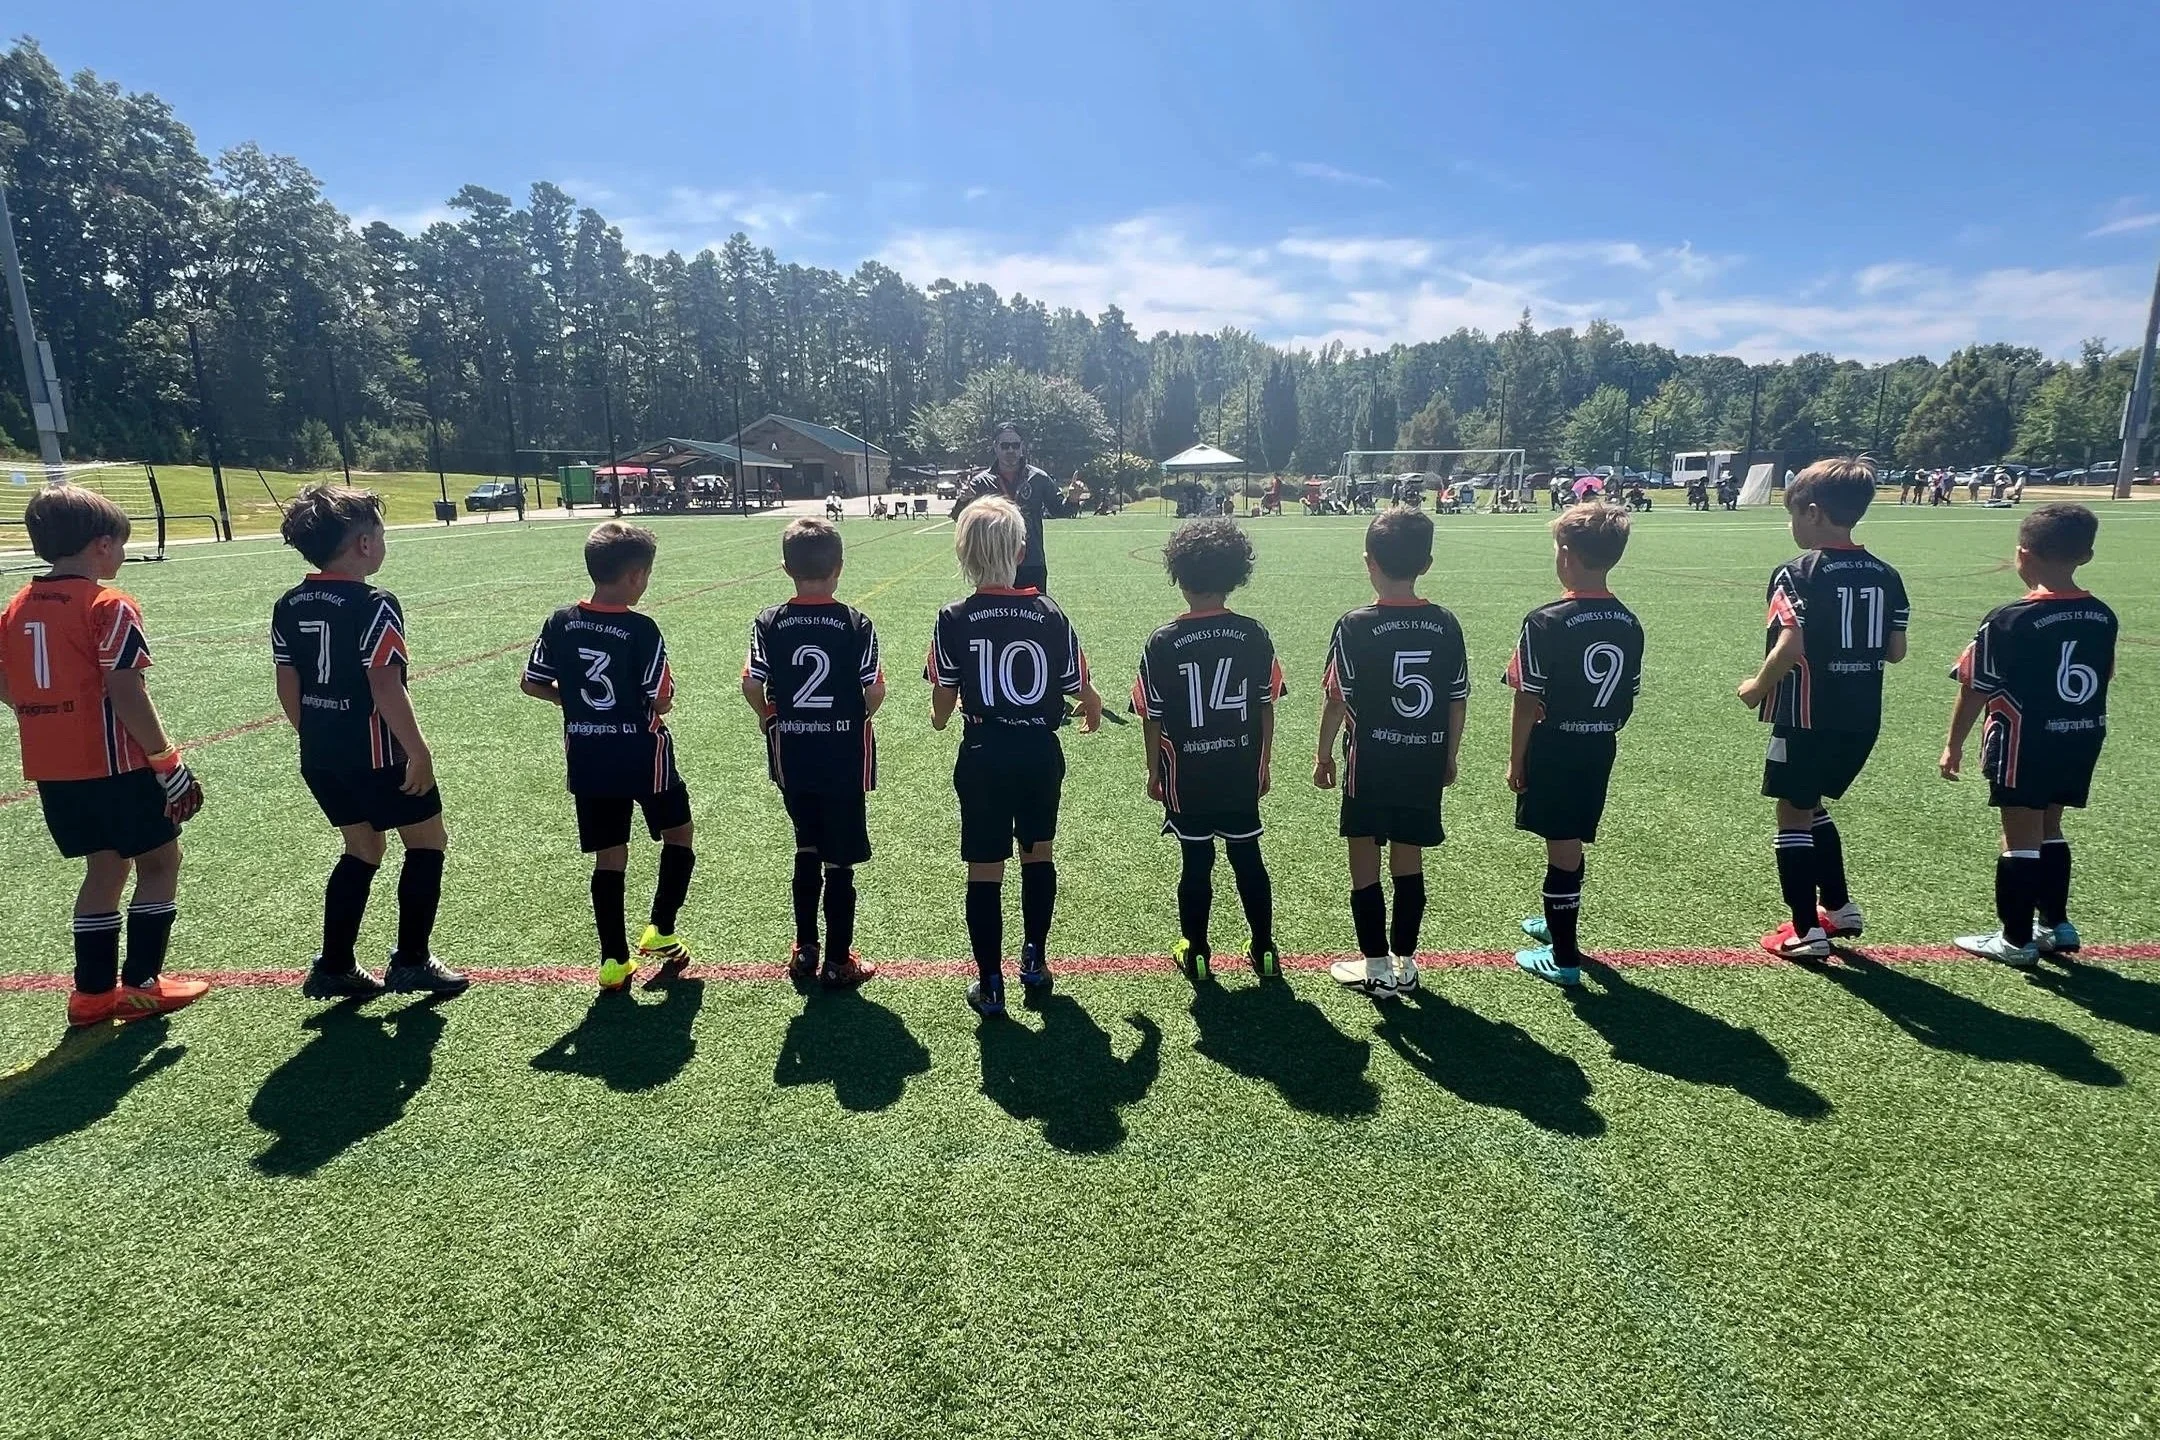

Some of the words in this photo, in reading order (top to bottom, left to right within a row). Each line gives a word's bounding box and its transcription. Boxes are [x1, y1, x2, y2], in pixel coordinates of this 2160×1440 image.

[669, 445, 676, 453] A
[771, 442, 778, 451] A
[321, 592, 346, 606] MAGIC
[777, 616, 813, 630] KINDNESS
[813, 616, 820, 625] IS
[821, 616, 847, 631] MAGIC
[968, 608, 1008, 623] KINDNESS
[1010, 608, 1018, 617] IS
[1019, 608, 1046, 624] MAGIC
[1565, 611, 1603, 628] KINDNESS
[1604, 611, 1613, 619] IS
[1837, 586, 1884, 649] 11
[2033, 611, 2072, 629] KINDNESS
[2074, 611, 2082, 620] IS
[595, 623, 604, 633] IS
[604, 625, 631, 640] MAGIC
[1372, 620, 1410, 636] KINDNESS
[1411, 620, 1419, 629] IS
[1174, 629, 1212, 649] KINDNESS
[1213, 629, 1220, 638] IS
[1221, 628, 1247, 641] MAGIC
[24, 621, 51, 689] 1
[299, 620, 331, 684] 7
[578, 647, 617, 711] 3
[791, 644, 834, 708] 2
[969, 638, 1048, 707] 10
[1583, 641, 1624, 708] 9
[2057, 640, 2098, 705] 6
[1178, 657, 1248, 728] 14
[1391, 650, 1434, 719] 5
[567, 721, 617, 736] alphagraphics
[622, 723, 637, 734] CLT
[778, 720, 831, 734] alphagraphics
[836, 720, 851, 731] CLT
[1560, 719, 1615, 734] alphagraphics
[1371, 727, 1427, 745] alphagraphics
[1431, 731, 1445, 743] CLT
[1183, 737, 1236, 754] alphagraphics
